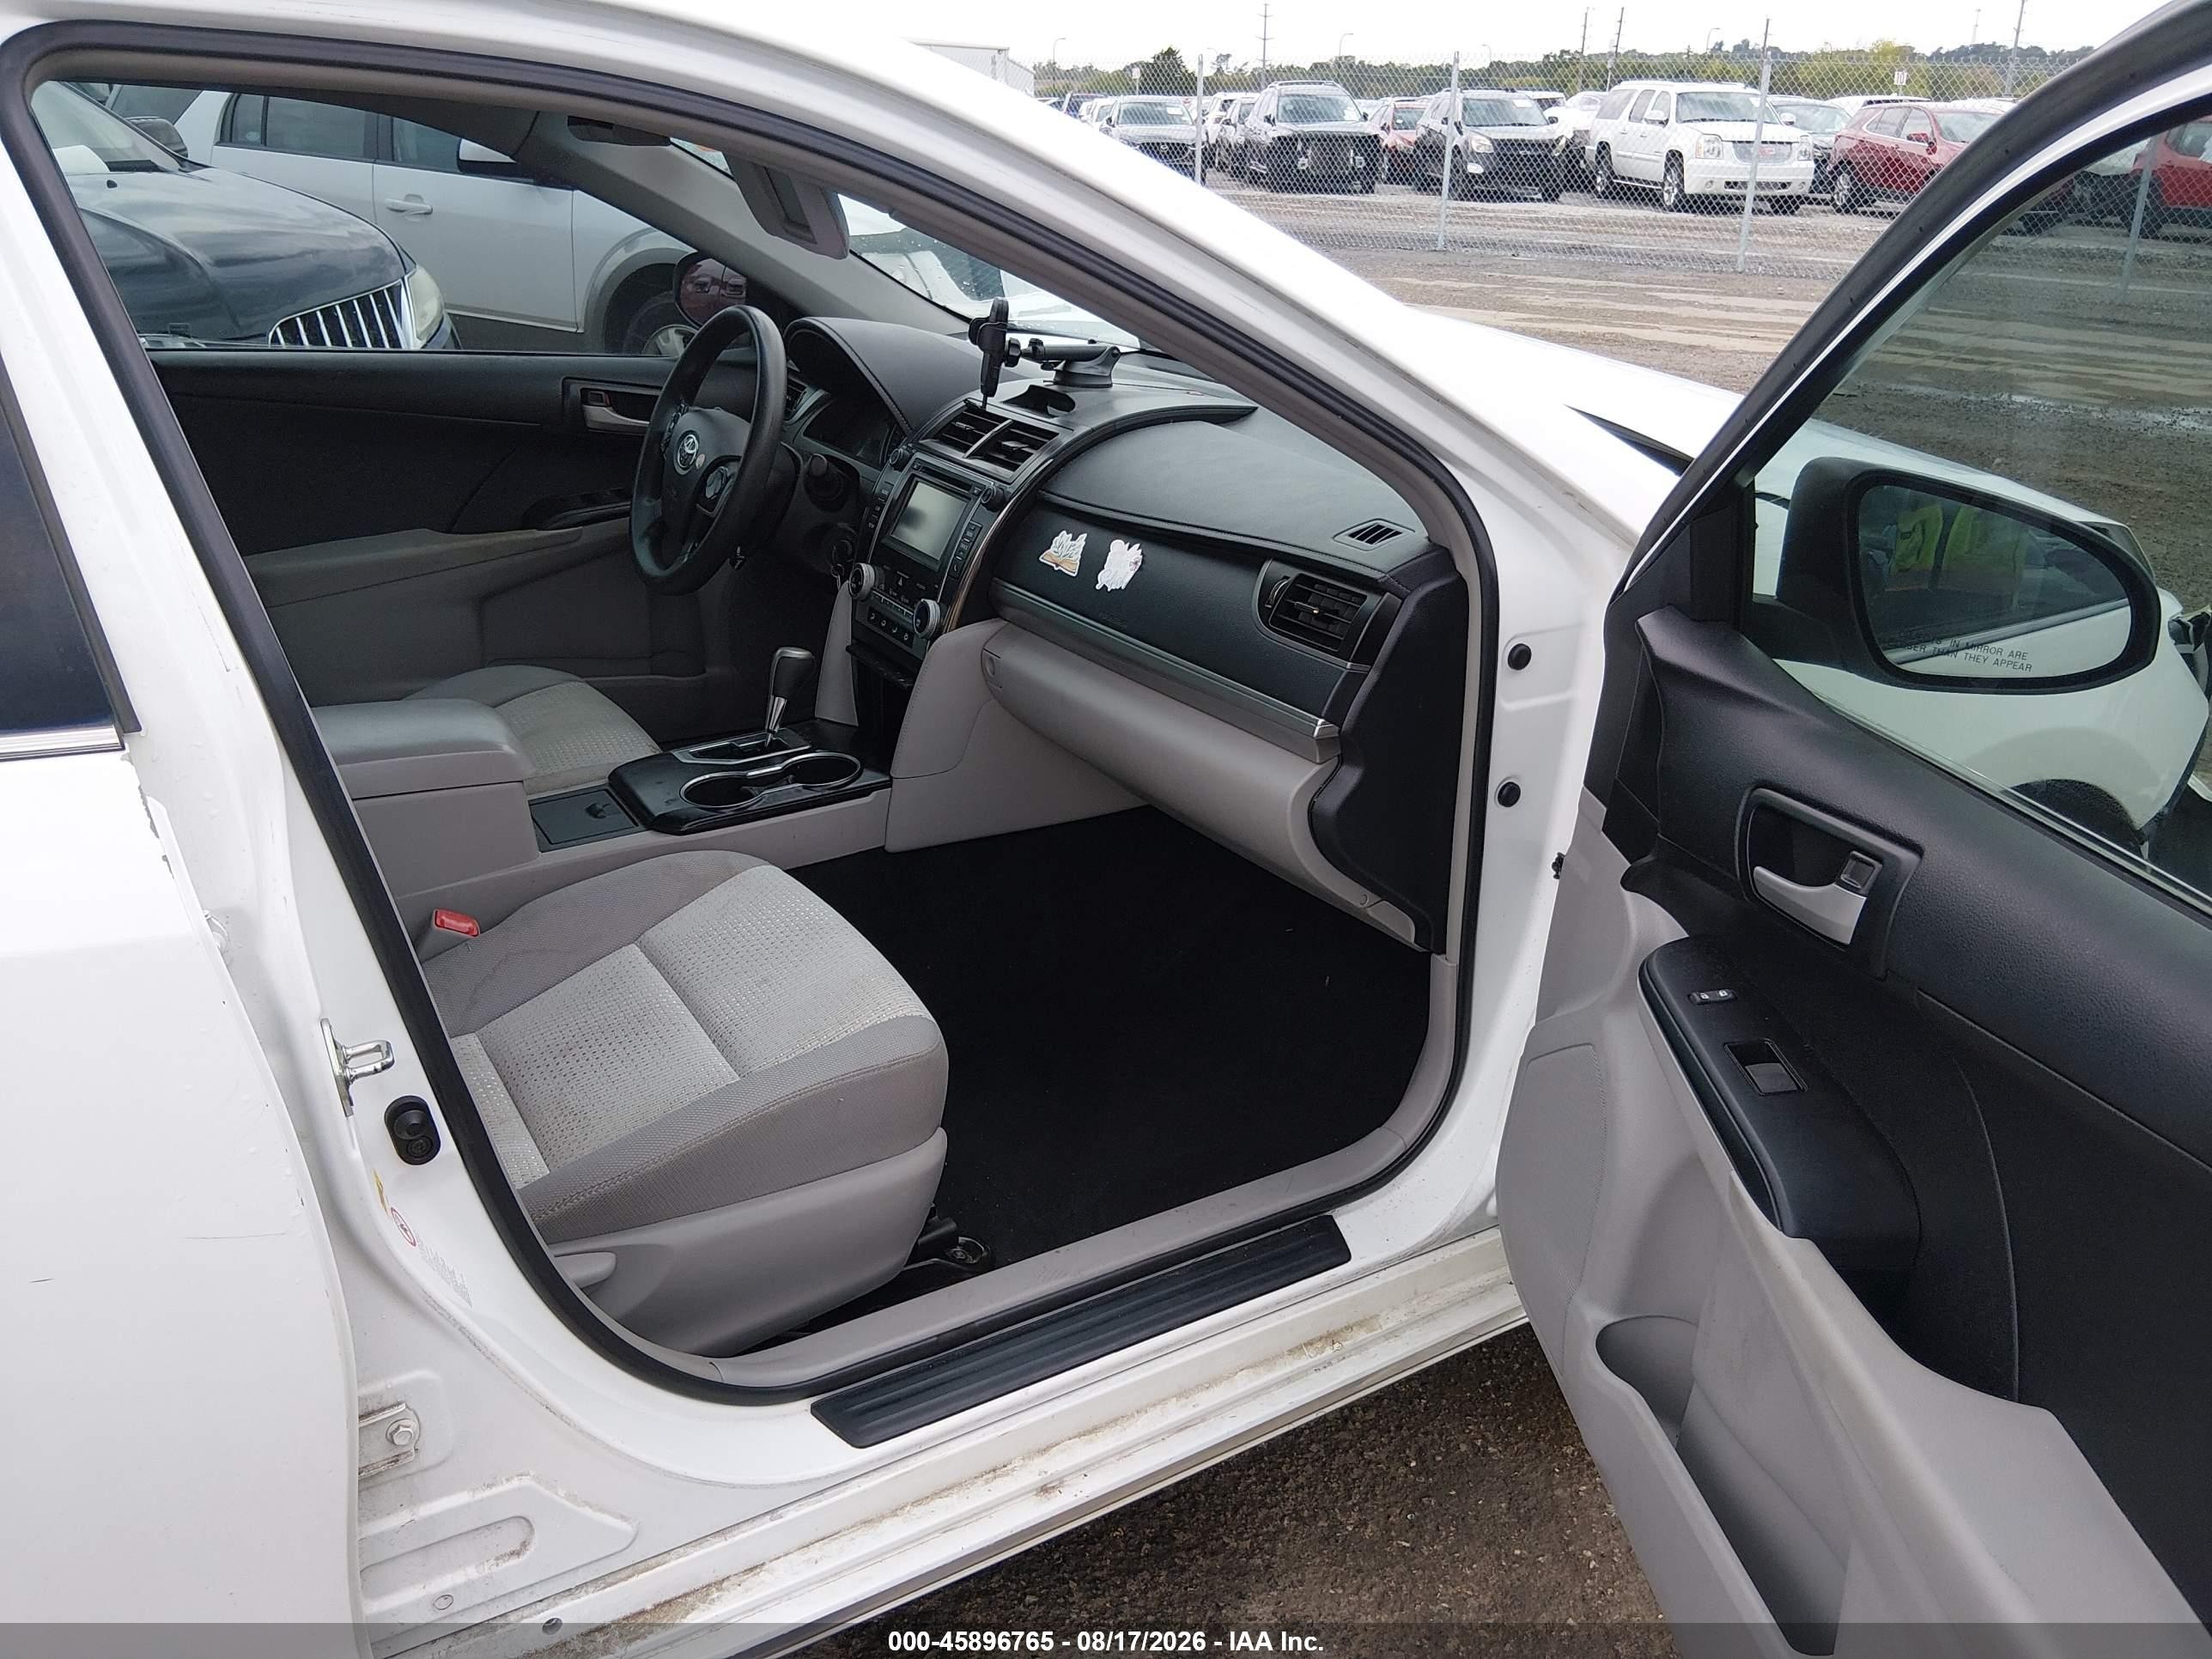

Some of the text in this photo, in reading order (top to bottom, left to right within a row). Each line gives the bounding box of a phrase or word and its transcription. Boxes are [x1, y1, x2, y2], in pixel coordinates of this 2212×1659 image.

[1949, 639, 2029, 660] IN MIRROR ARE
[1964, 652, 1989, 665] THEY
[1992, 659, 2033, 672] APPEAR
